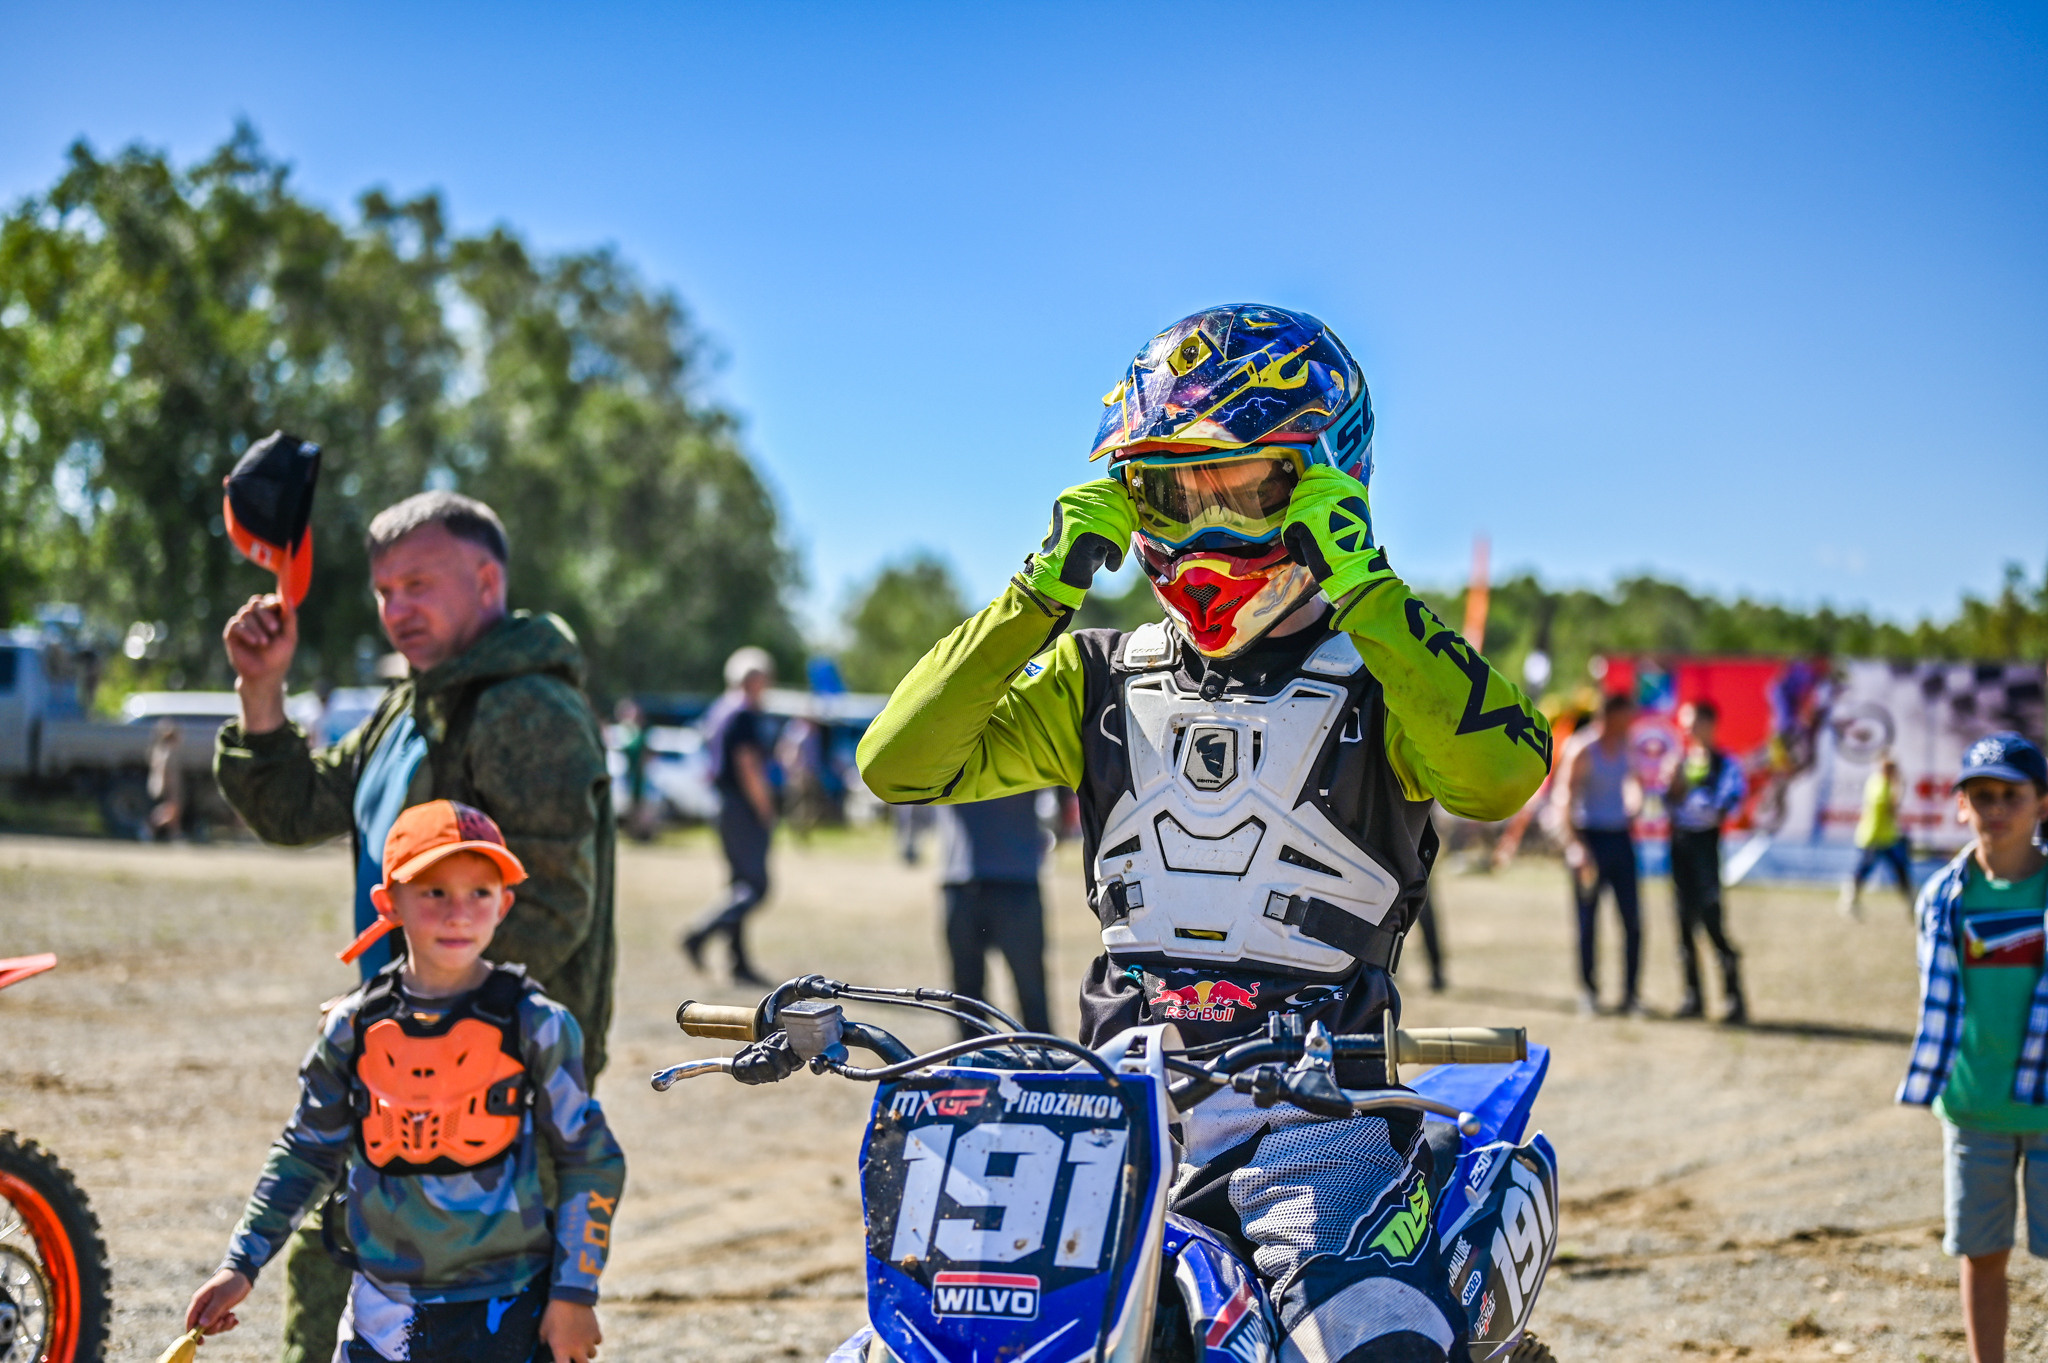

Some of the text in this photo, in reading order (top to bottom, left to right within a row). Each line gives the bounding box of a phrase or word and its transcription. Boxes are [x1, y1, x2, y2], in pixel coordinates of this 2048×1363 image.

[1165, 1006, 1235, 1022] Red Bull
[888, 1088, 988, 1121] MXGP
[890, 1123, 1128, 1269] 191
[578, 1189, 617, 1277] FOX
[1490, 1158, 1554, 1326] 191
[936, 1286, 1035, 1315] WILVO
[1463, 1271, 1482, 1304] SHOEI
